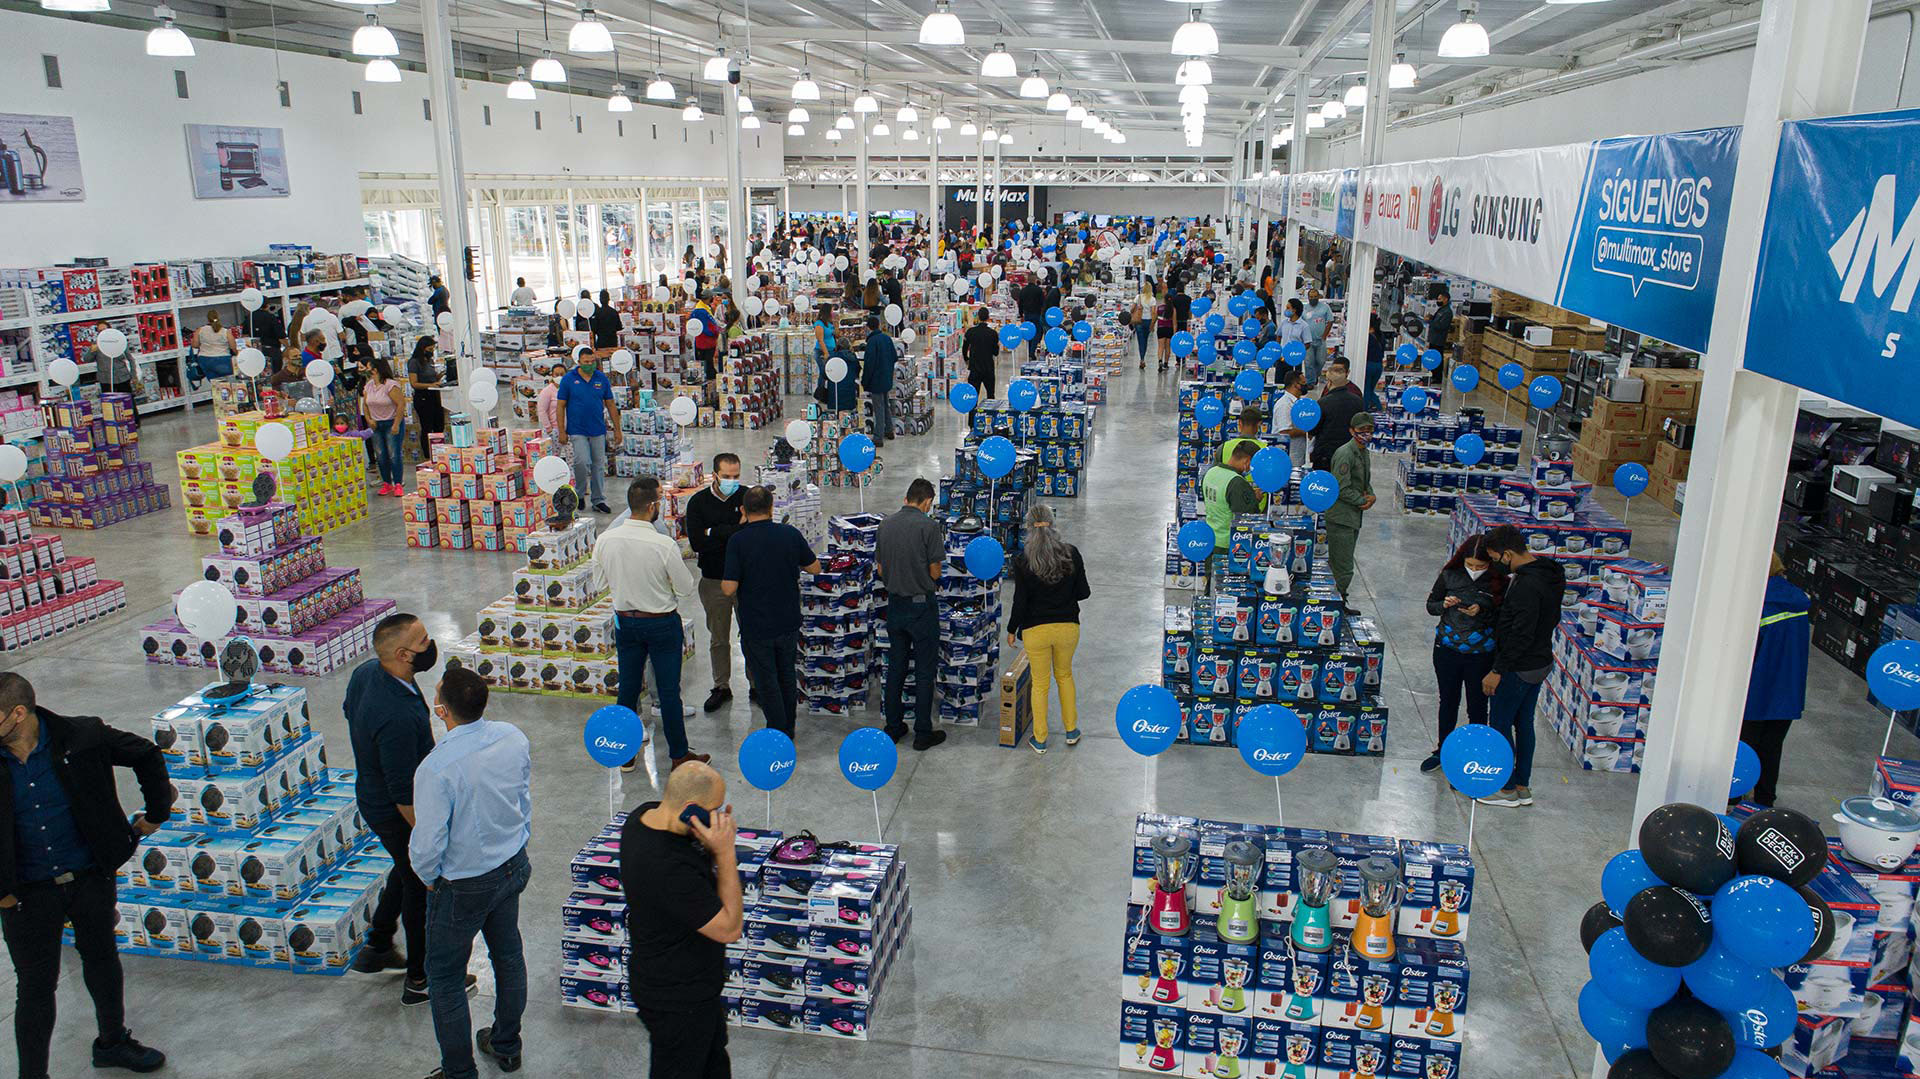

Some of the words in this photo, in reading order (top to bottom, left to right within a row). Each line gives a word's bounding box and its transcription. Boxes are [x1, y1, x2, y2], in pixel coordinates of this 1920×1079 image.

[1470, 193, 1543, 245] SAMSUNG
[1596, 236, 1693, 273] @multimax_store
[1255, 540, 1270, 550] Ost
[1260, 601, 1284, 612] Oster
[1302, 604, 1327, 615] Oster
[1166, 634, 1186, 644] Oster
[1197, 653, 1219, 664] Oster
[1240, 656, 1264, 666] Oster
[1282, 658, 1305, 668] Oster
[1324, 660, 1348, 671] Oster
[1194, 702, 1217, 712] Oster
[1318, 709, 1341, 720] Oster
[1360, 711, 1381, 721] Oster
[1132, 719, 1171, 734] Oster
[594, 735, 628, 751] Oster
[1253, 748, 1293, 761] Oster
[769, 758, 795, 773] Oster
[848, 760, 880, 774] Oster
[1463, 760, 1503, 776] Oster
[1761, 836, 1795, 866] DECKER
[764, 867, 782, 875] Oster
[1728, 876, 1774, 895] Oster
[749, 921, 768, 929] Oster
[810, 929, 827, 937] Oster
[1193, 945, 1218, 955] Oster
[1263, 951, 1289, 961] Oster
[743, 960, 762, 968] Oster
[1401, 967, 1428, 978] Oster
[561, 978, 579, 986] Oster
[742, 999, 760, 1007] Oster
[804, 1008, 821, 1016] Oster
[1124, 1005, 1149, 1016] Oster
[1189, 1015, 1214, 1025] Oster
[1256, 1021, 1281, 1032] Oster
[1746, 1008, 1769, 1047] Oster
[1325, 1030, 1351, 1041] Oster
[1394, 1039, 1420, 1050] Oster
